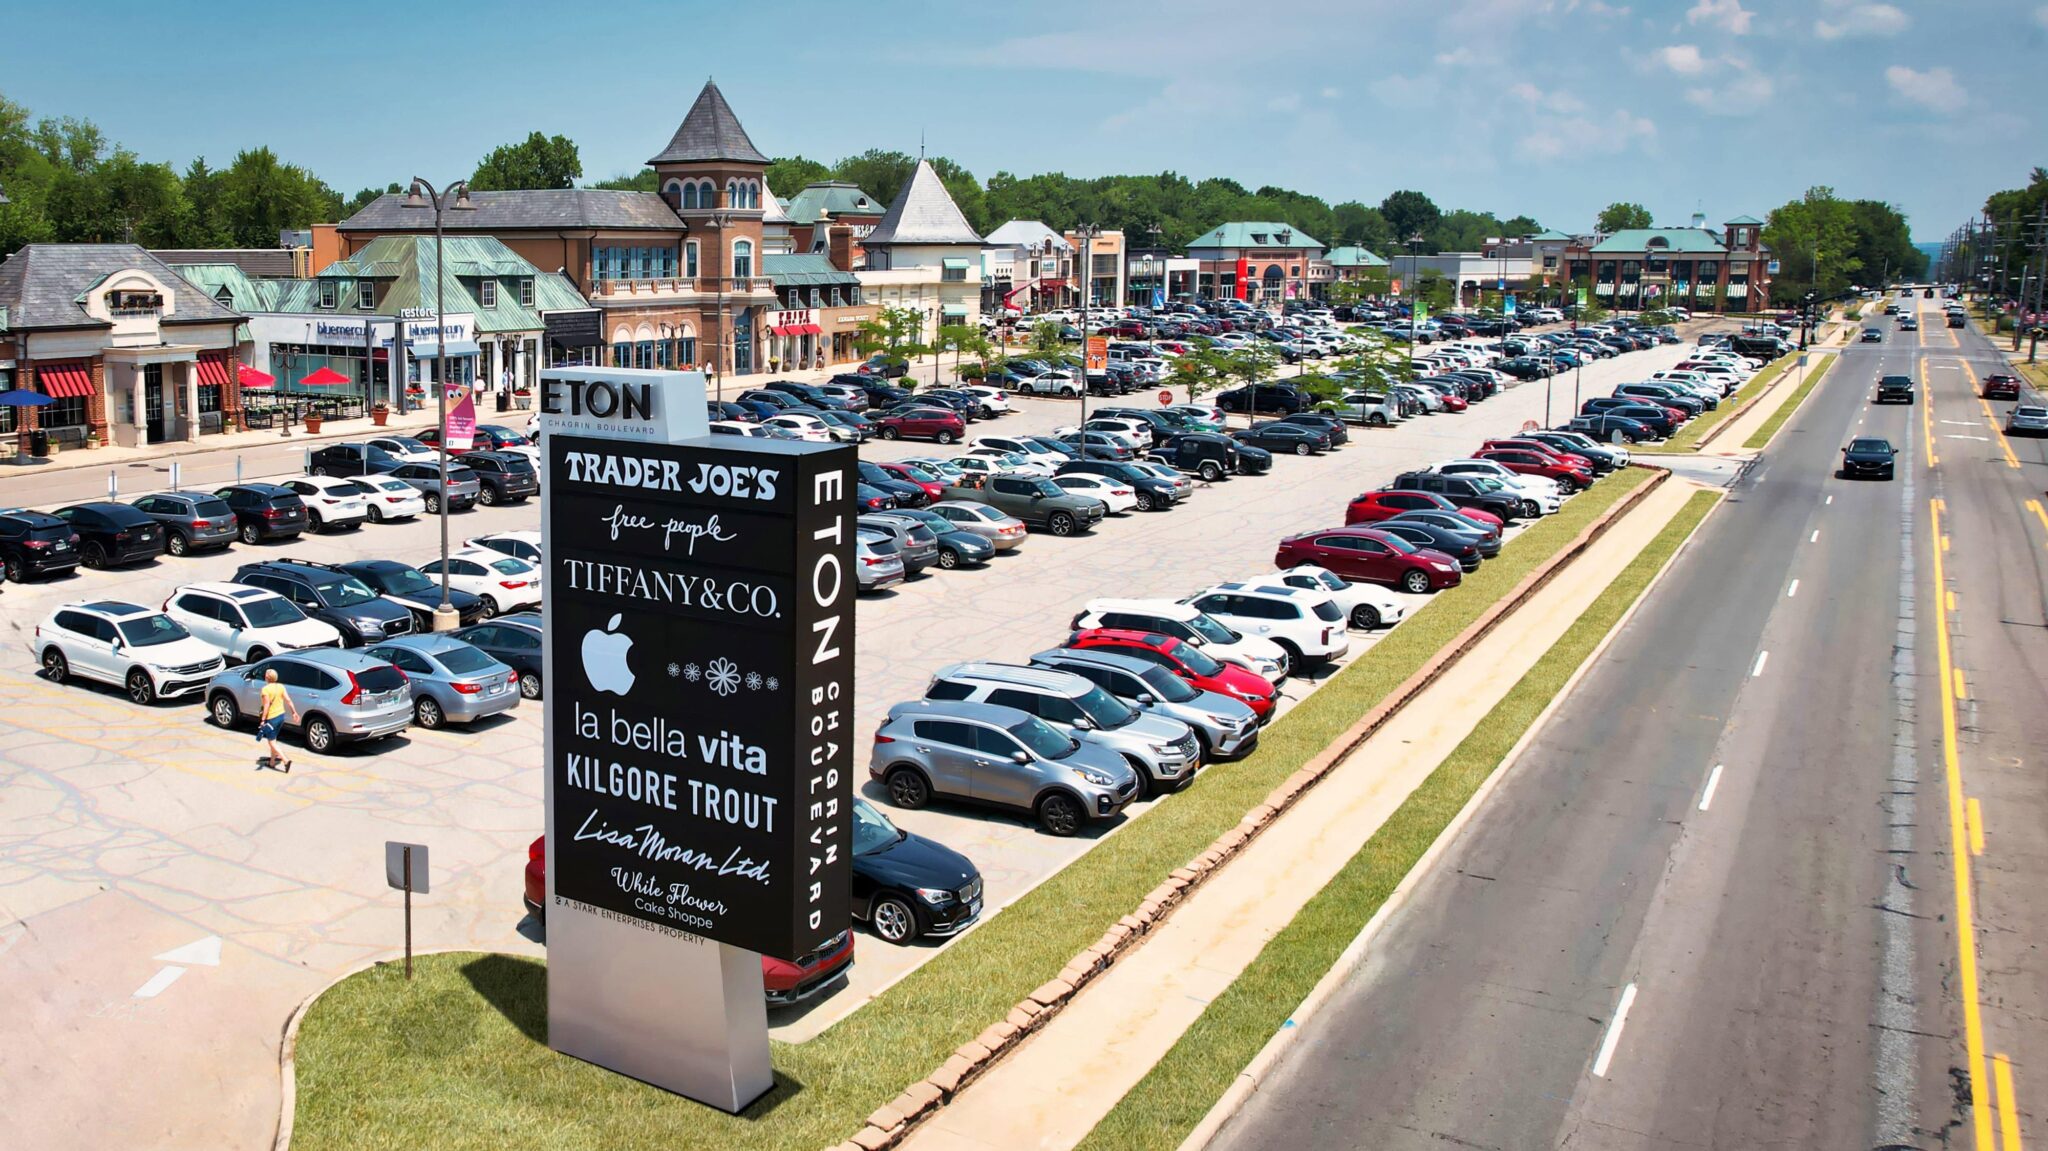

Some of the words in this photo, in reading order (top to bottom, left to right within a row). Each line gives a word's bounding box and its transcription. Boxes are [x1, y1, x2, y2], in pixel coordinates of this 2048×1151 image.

[317, 321, 376, 338] bluemercuy
[400, 306, 434, 318] restore
[409, 323, 465, 338] bluemcury
[541, 378, 651, 420] ETON
[548, 420, 590, 430] CHAGRIN
[597, 424, 654, 435] BOULEVARD
[565, 452, 682, 492] TRADER
[688, 464, 779, 500] JOE'S
[602, 504, 655, 541] free
[661, 514, 737, 556] people
[813, 470, 842, 664] ETON
[575, 702, 600, 740] la
[611, 708, 687, 758] bella
[698, 730, 767, 776] vita
[567, 753, 678, 811] KILGORE
[688, 780, 778, 833] TROUT
[826, 681, 839, 865] CHAGRIN
[810, 686, 824, 930] BOULEVARD
[611, 867, 663, 897] White
[666, 883, 728, 916] Flower
[634, 897, 666, 916] Cake
[668, 906, 713, 929] Shoppe
[564, 900, 570, 908] A
[573, 901, 598, 916] STARK
[601, 908, 656, 932] ENTERPRISES
[658, 925, 705, 946] PROPERTY
